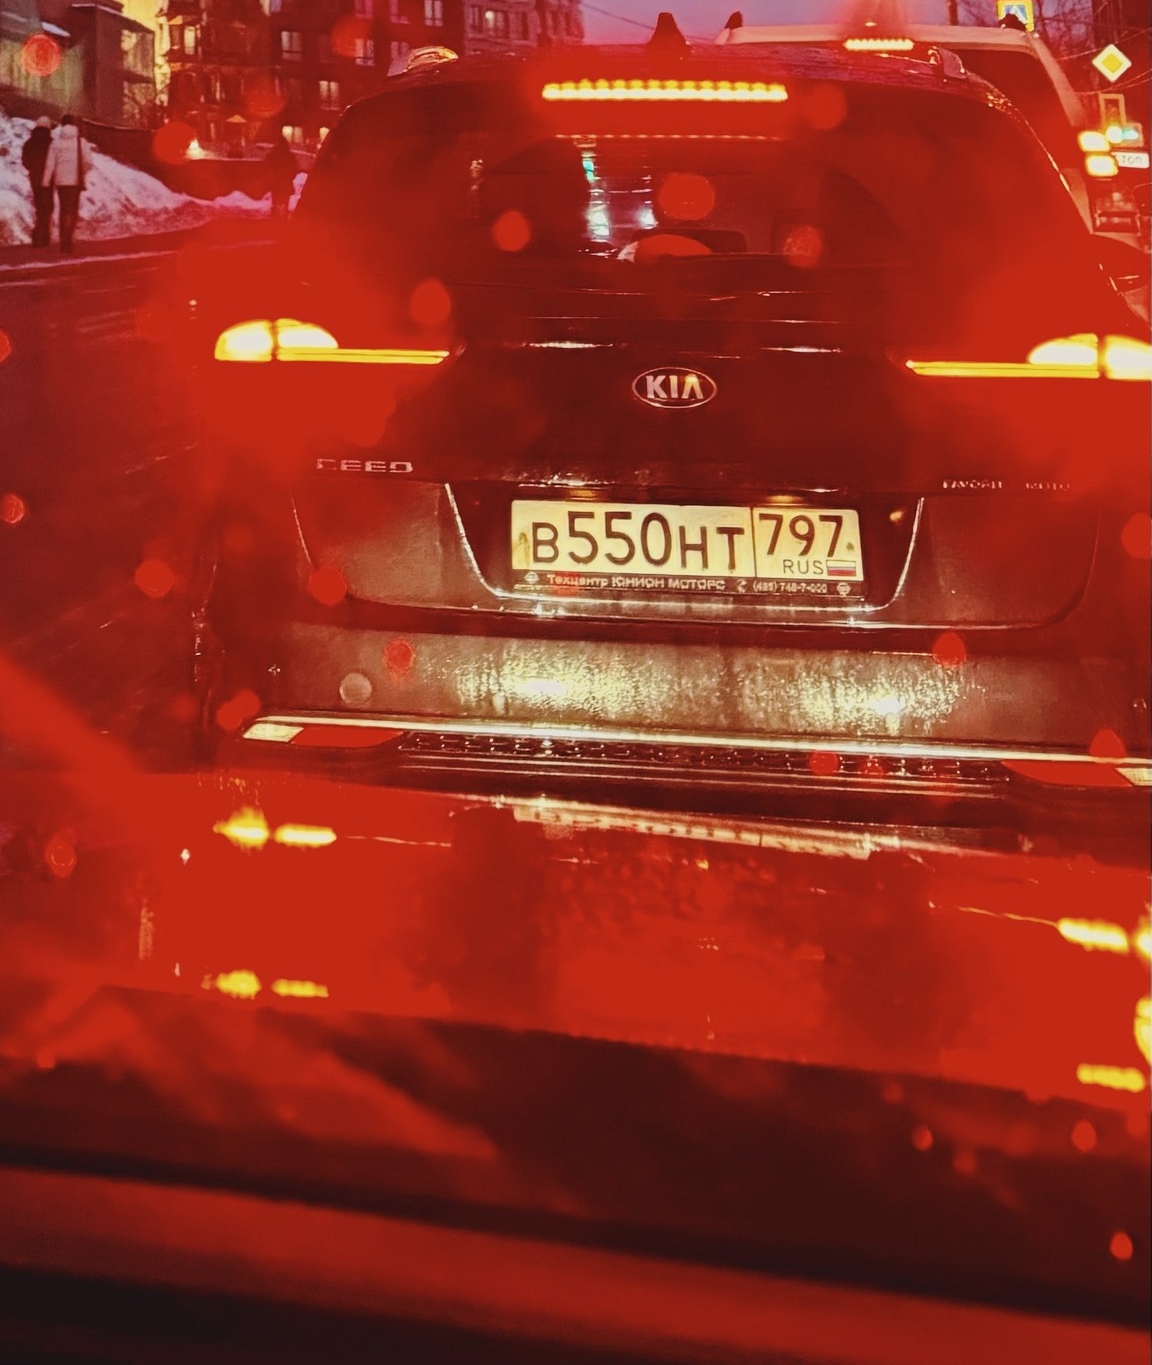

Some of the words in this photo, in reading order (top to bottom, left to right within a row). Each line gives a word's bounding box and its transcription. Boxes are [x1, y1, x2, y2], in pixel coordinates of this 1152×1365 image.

[645, 374, 704, 399] KIA
[531, 511, 746, 571] В550НТ
[758, 513, 844, 558] 797
[782, 559, 825, 575] RUS
